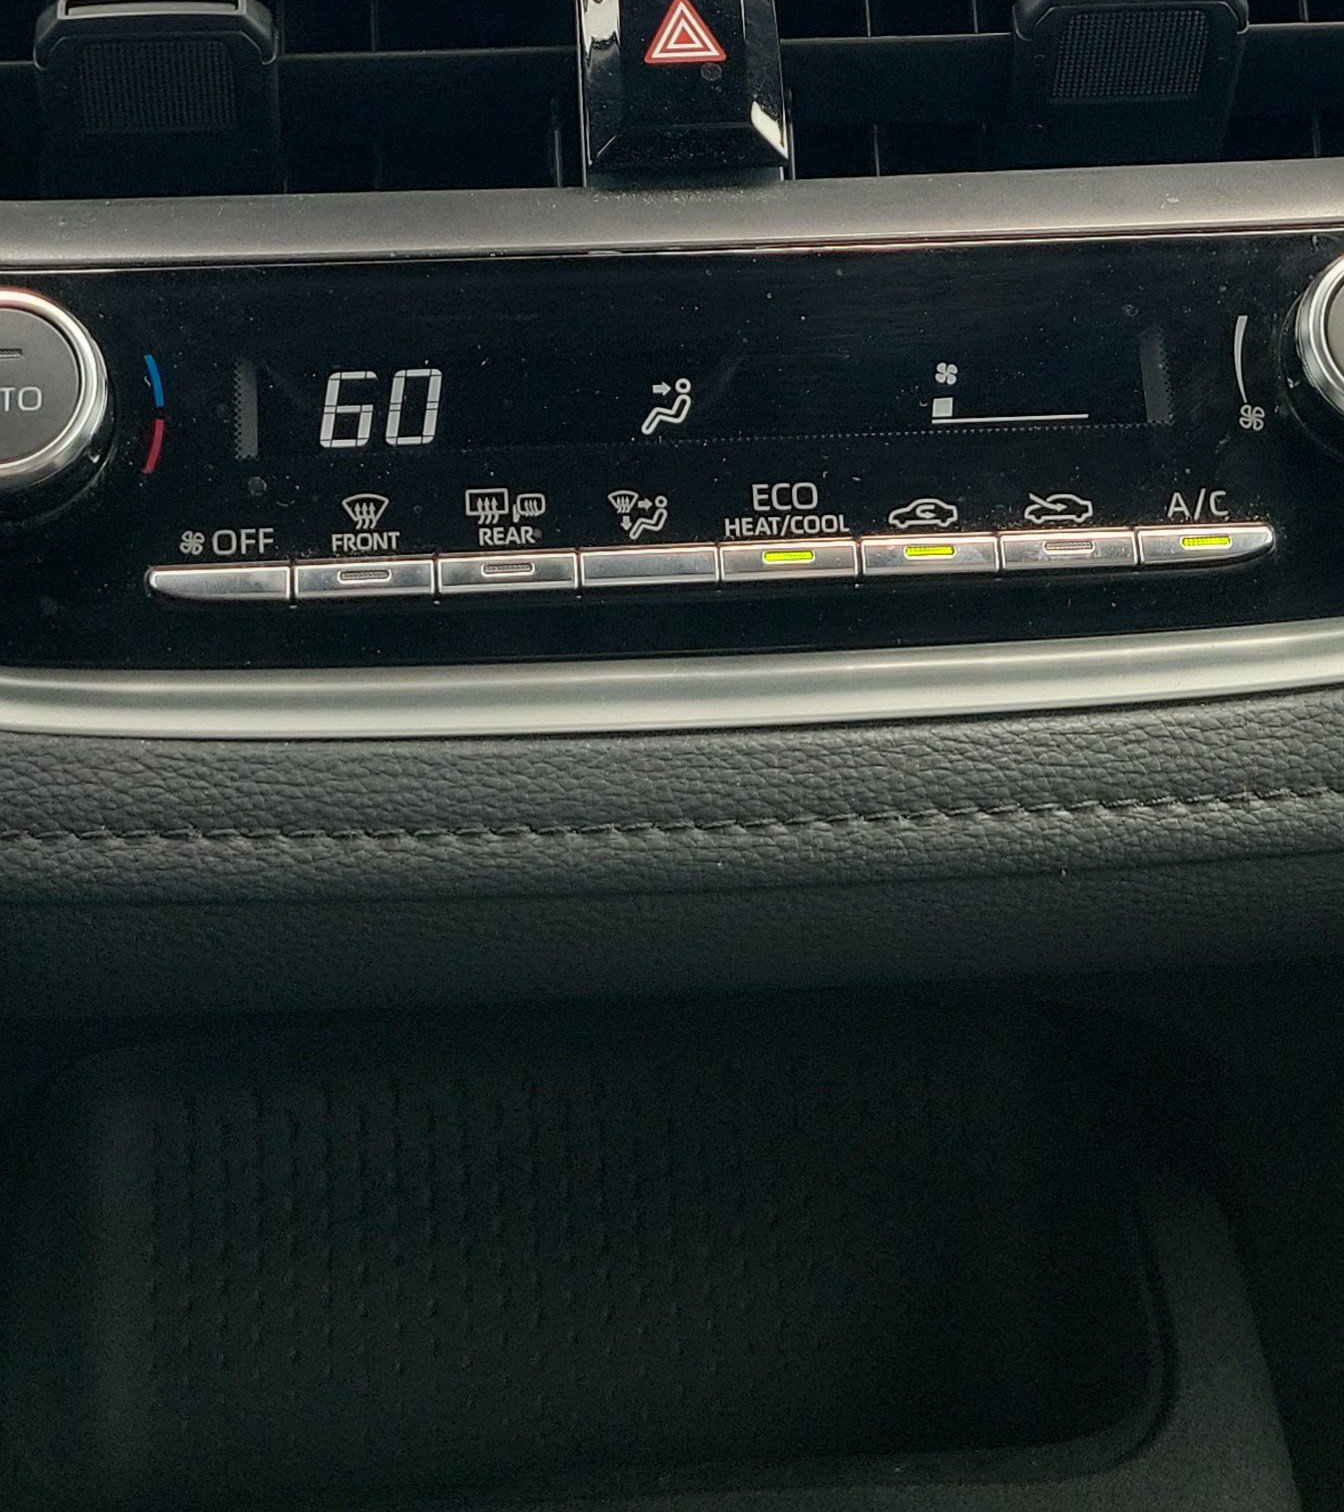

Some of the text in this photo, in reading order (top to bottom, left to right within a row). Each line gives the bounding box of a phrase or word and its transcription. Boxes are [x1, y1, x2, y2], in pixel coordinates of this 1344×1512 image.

[319, 368, 443, 449] 60
[752, 482, 818, 511] ECO
[1167, 489, 1230, 520] A/C
[478, 526, 536, 547] REAR
[724, 513, 851, 539] HEAT/COOL
[211, 527, 275, 556] OFF
[331, 531, 401, 553] FRONT
